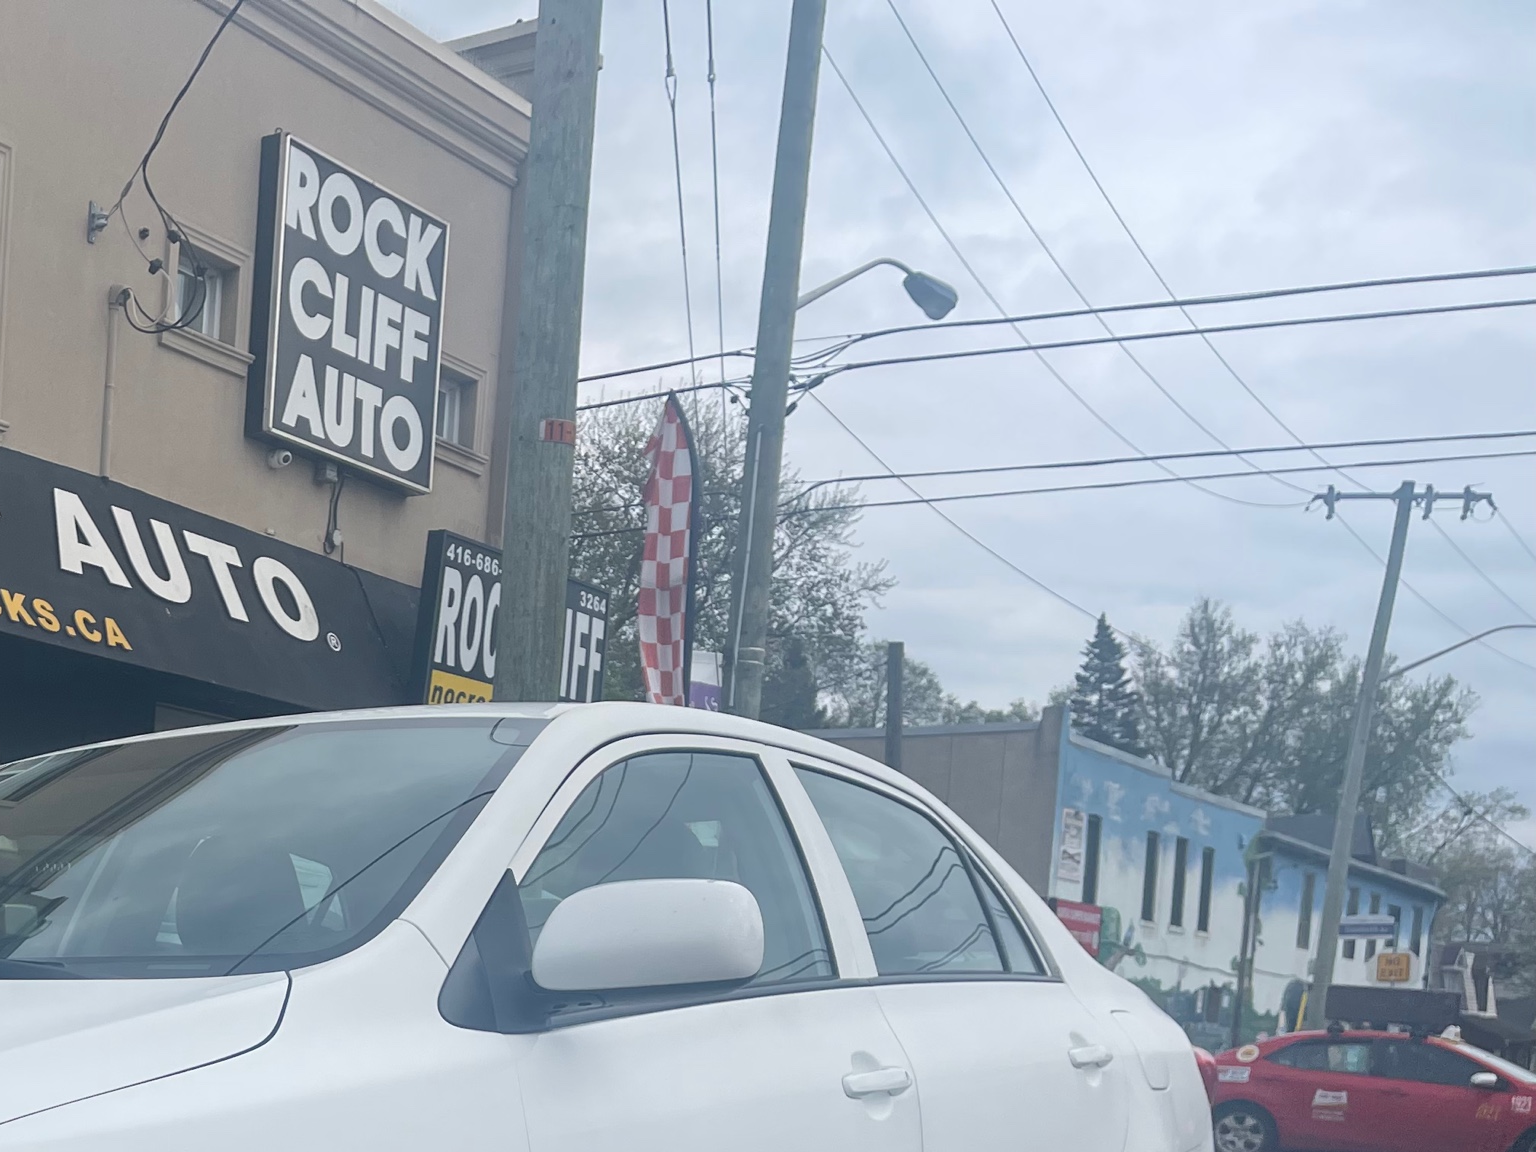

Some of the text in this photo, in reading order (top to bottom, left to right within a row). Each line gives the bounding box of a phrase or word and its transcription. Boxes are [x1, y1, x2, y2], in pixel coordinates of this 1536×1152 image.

[285, 144, 443, 301] ROCK
[289, 257, 431, 384] CLIFF
[281, 353, 424, 473] AUTO
